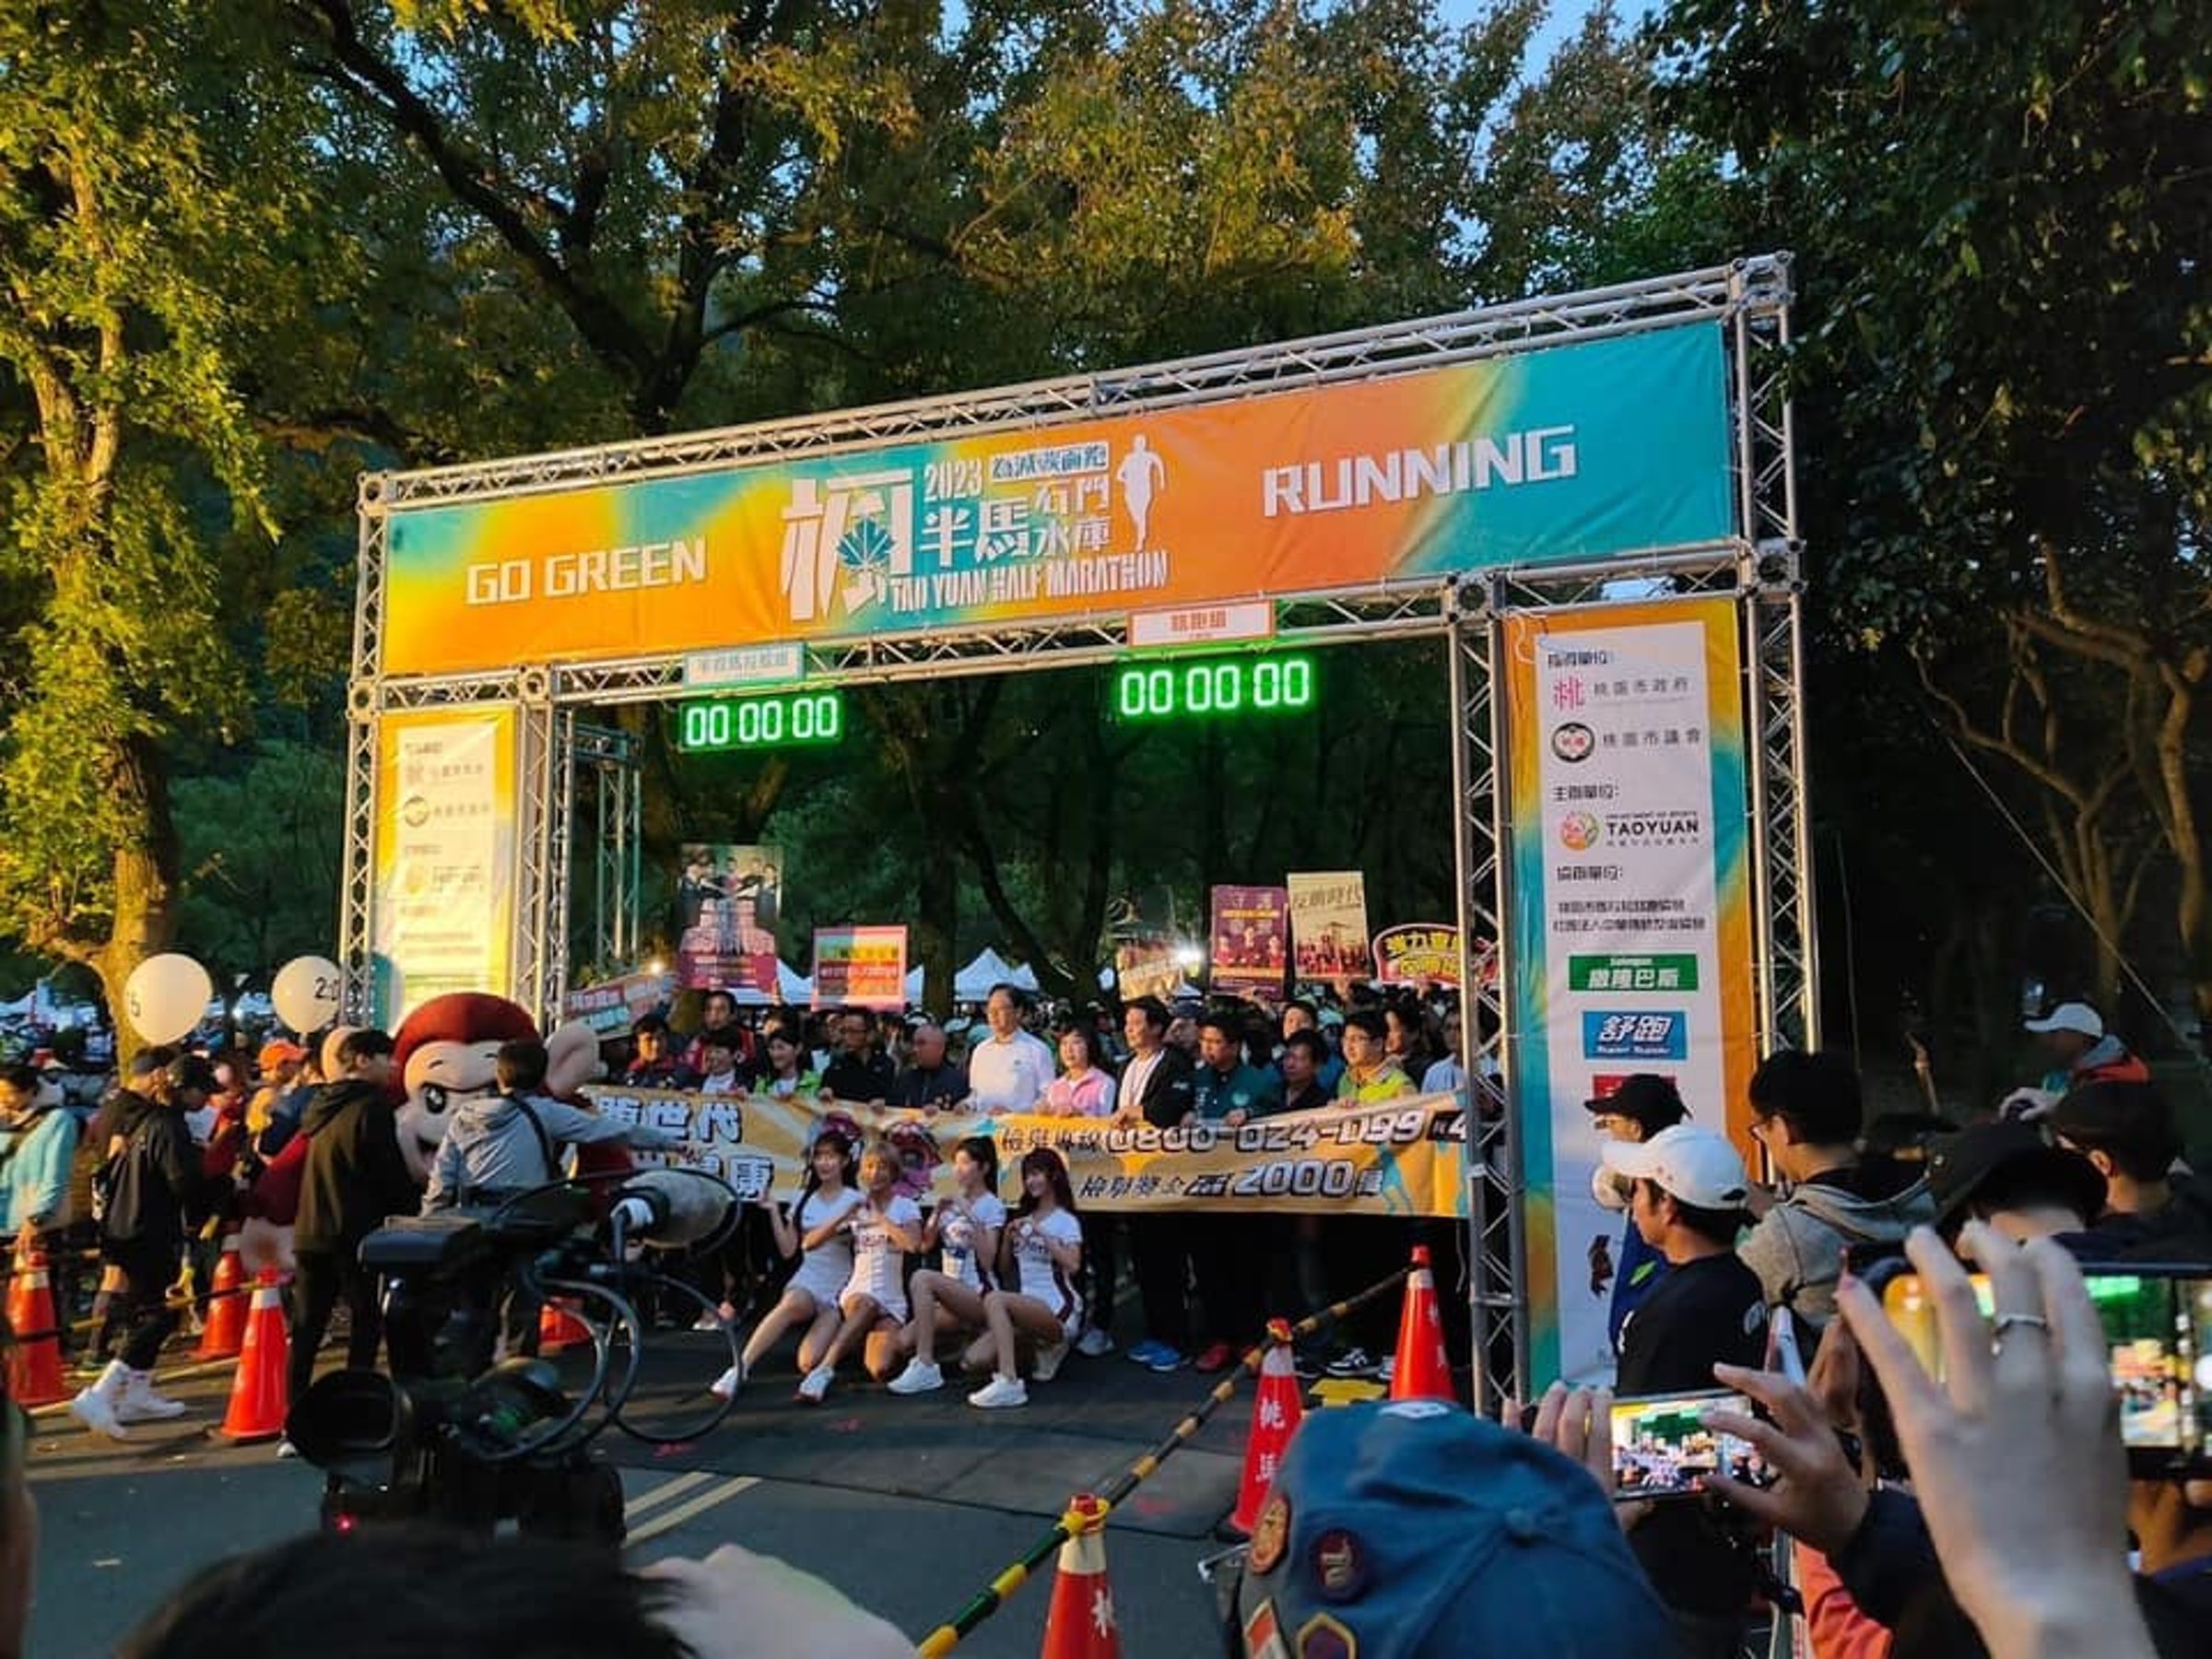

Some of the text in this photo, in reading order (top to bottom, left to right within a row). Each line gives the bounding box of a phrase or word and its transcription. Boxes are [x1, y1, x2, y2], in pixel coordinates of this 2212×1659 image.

[923, 461, 982, 502] 2023
[1263, 424, 1577, 517] RUNNING
[1034, 474, 1110, 516] 石門
[920, 497, 1030, 568] 半馬
[1031, 516, 1112, 557] 水庫
[465, 535, 707, 606] GO GREEN
[891, 550, 1169, 612] TAO YUAN HALF MARATHON
[1606, 819, 1699, 836] TAOYUAN
[1598, 1015, 1672, 1041] 舒跑
